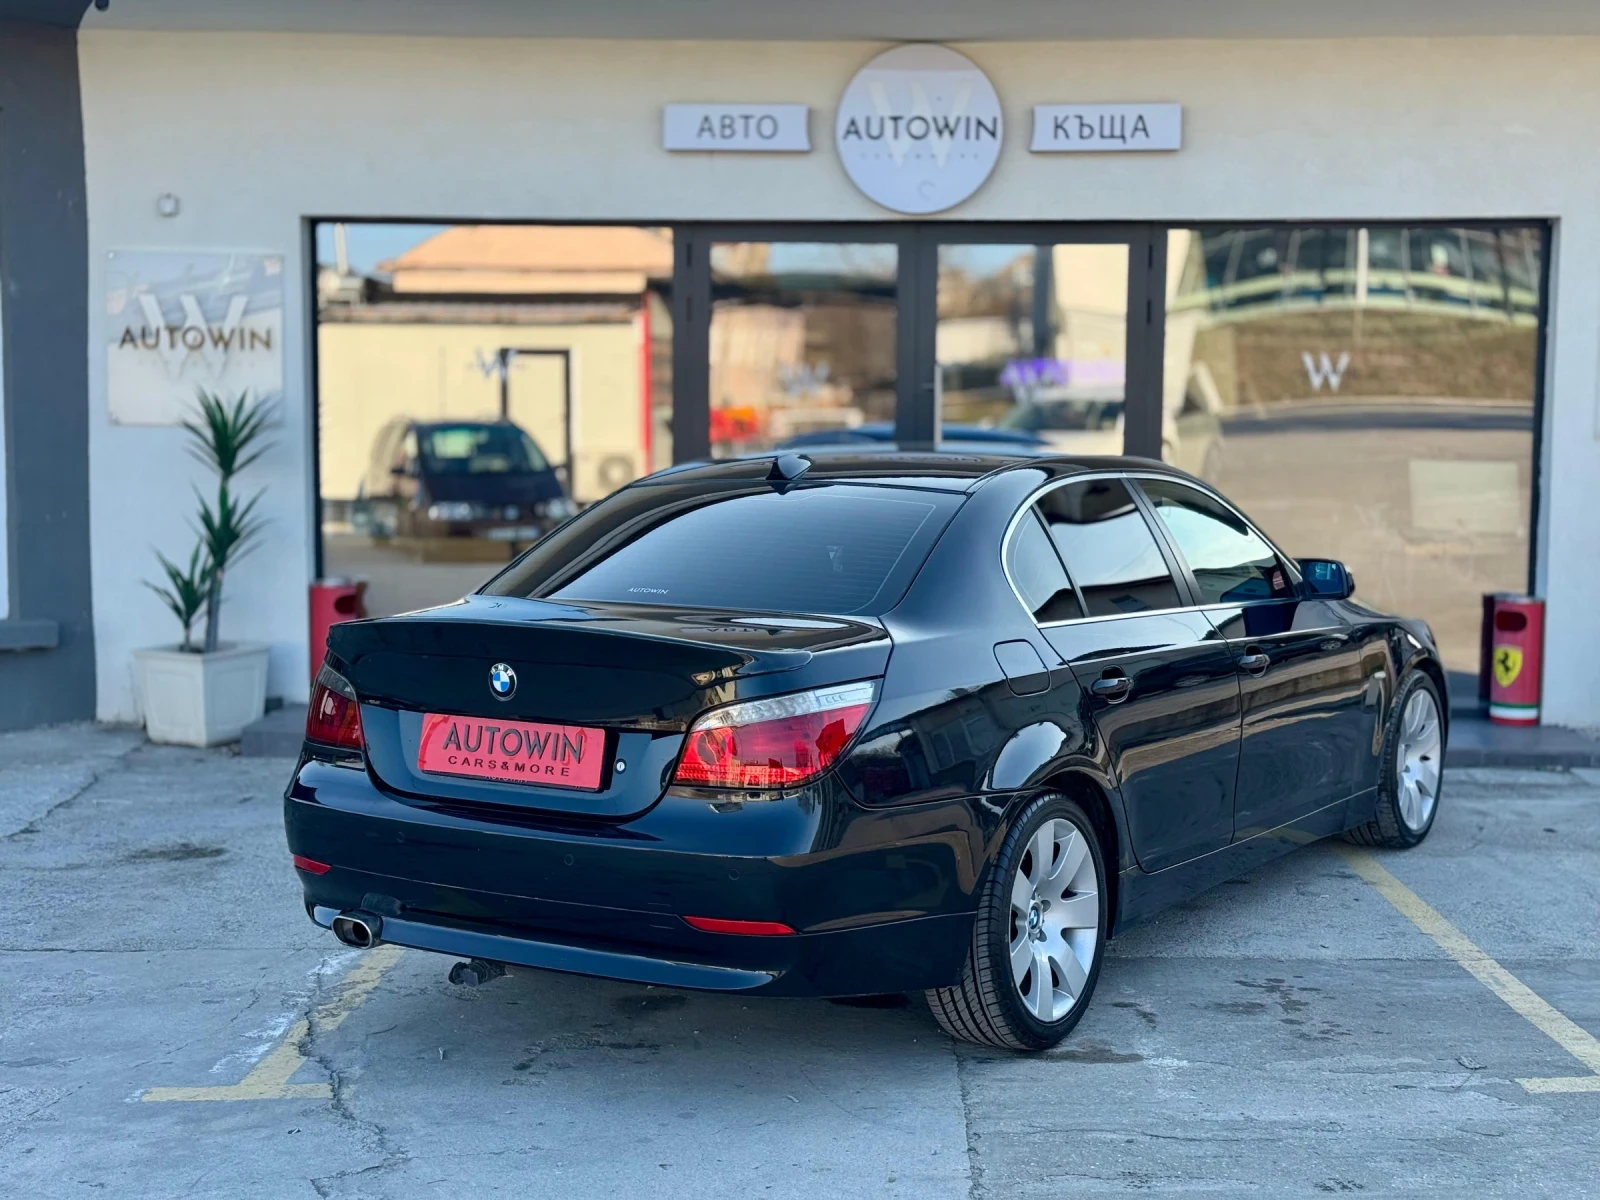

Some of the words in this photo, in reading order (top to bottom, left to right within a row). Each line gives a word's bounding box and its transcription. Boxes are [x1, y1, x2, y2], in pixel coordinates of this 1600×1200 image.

[697, 115, 778, 140] АВТО
[842, 115, 998, 141] AUTOWIN
[1053, 113, 1150, 144] КЪЩА
[119, 325, 272, 351] AUTOWIN
[1301, 351, 1351, 392] W
[627, 587, 669, 595] AUTOWIN
[442, 721, 583, 764] AUTOWIN
[447, 755, 570, 777] CARS&MORE
